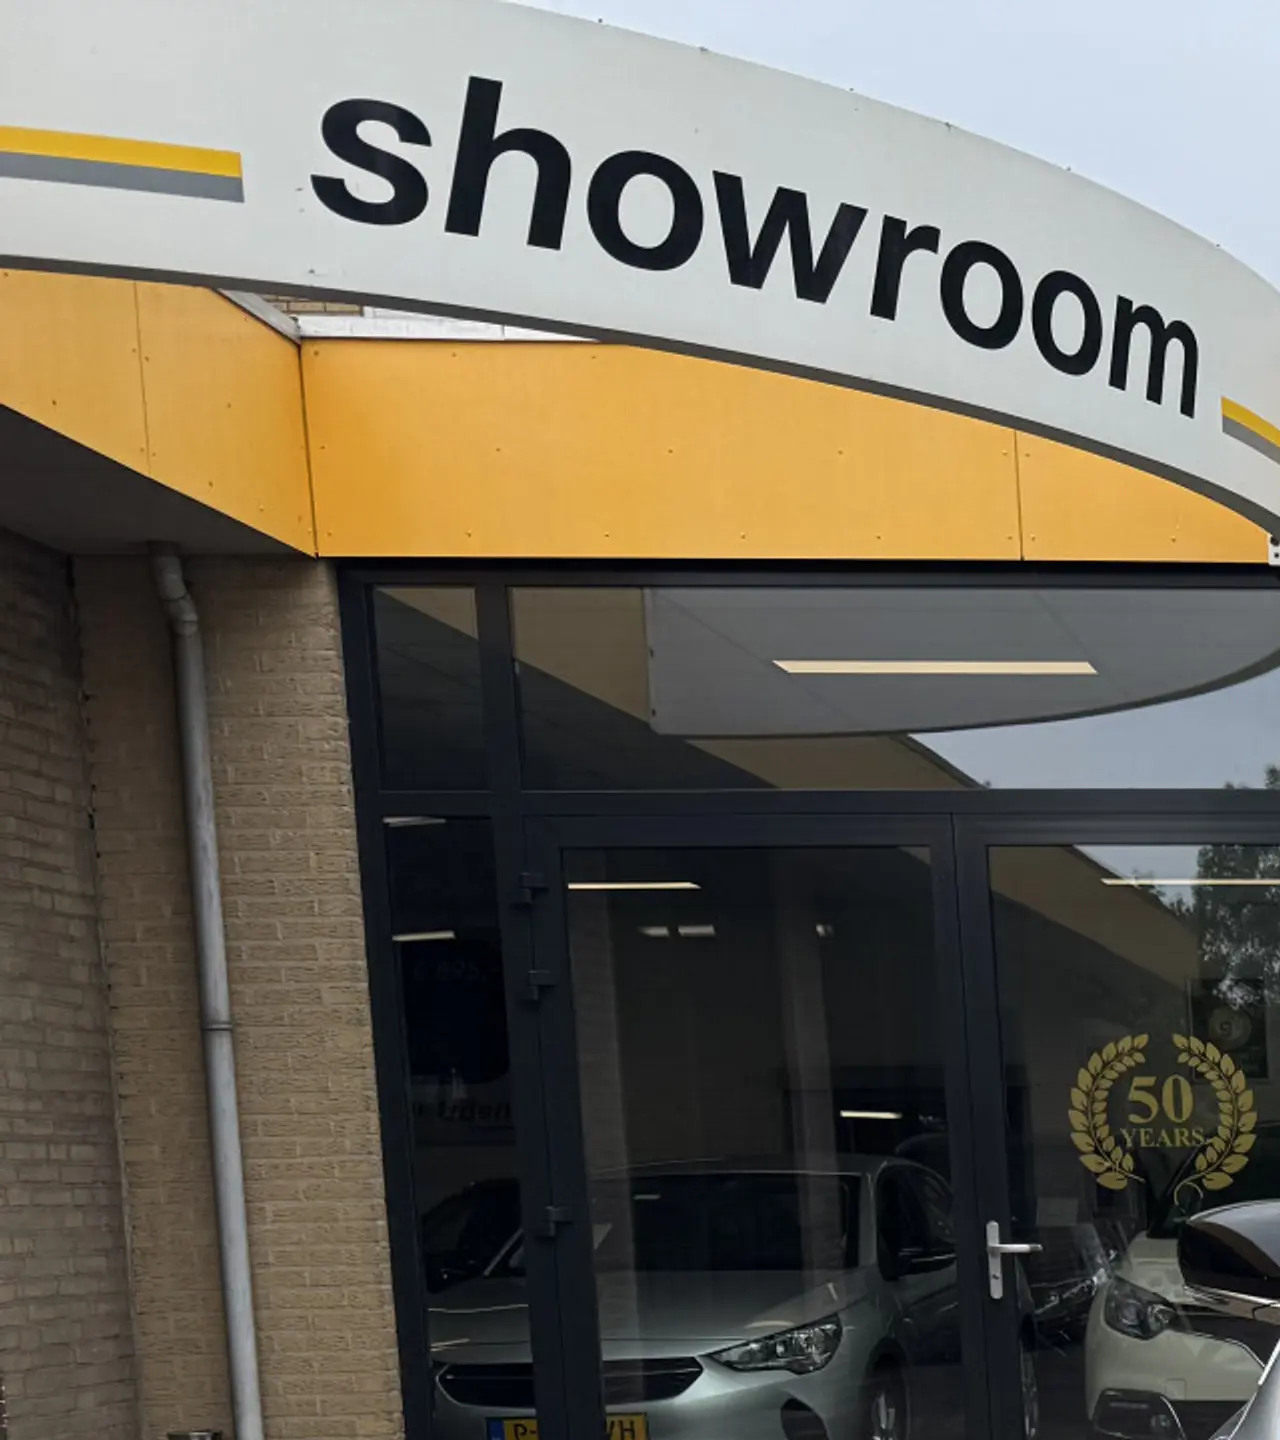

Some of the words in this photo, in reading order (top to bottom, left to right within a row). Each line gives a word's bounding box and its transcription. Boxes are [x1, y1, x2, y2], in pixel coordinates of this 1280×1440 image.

[310, 75, 1201, 418] showroom
[1127, 1074, 1194, 1124] 50
[1119, 1127, 1206, 1149] YEARS
